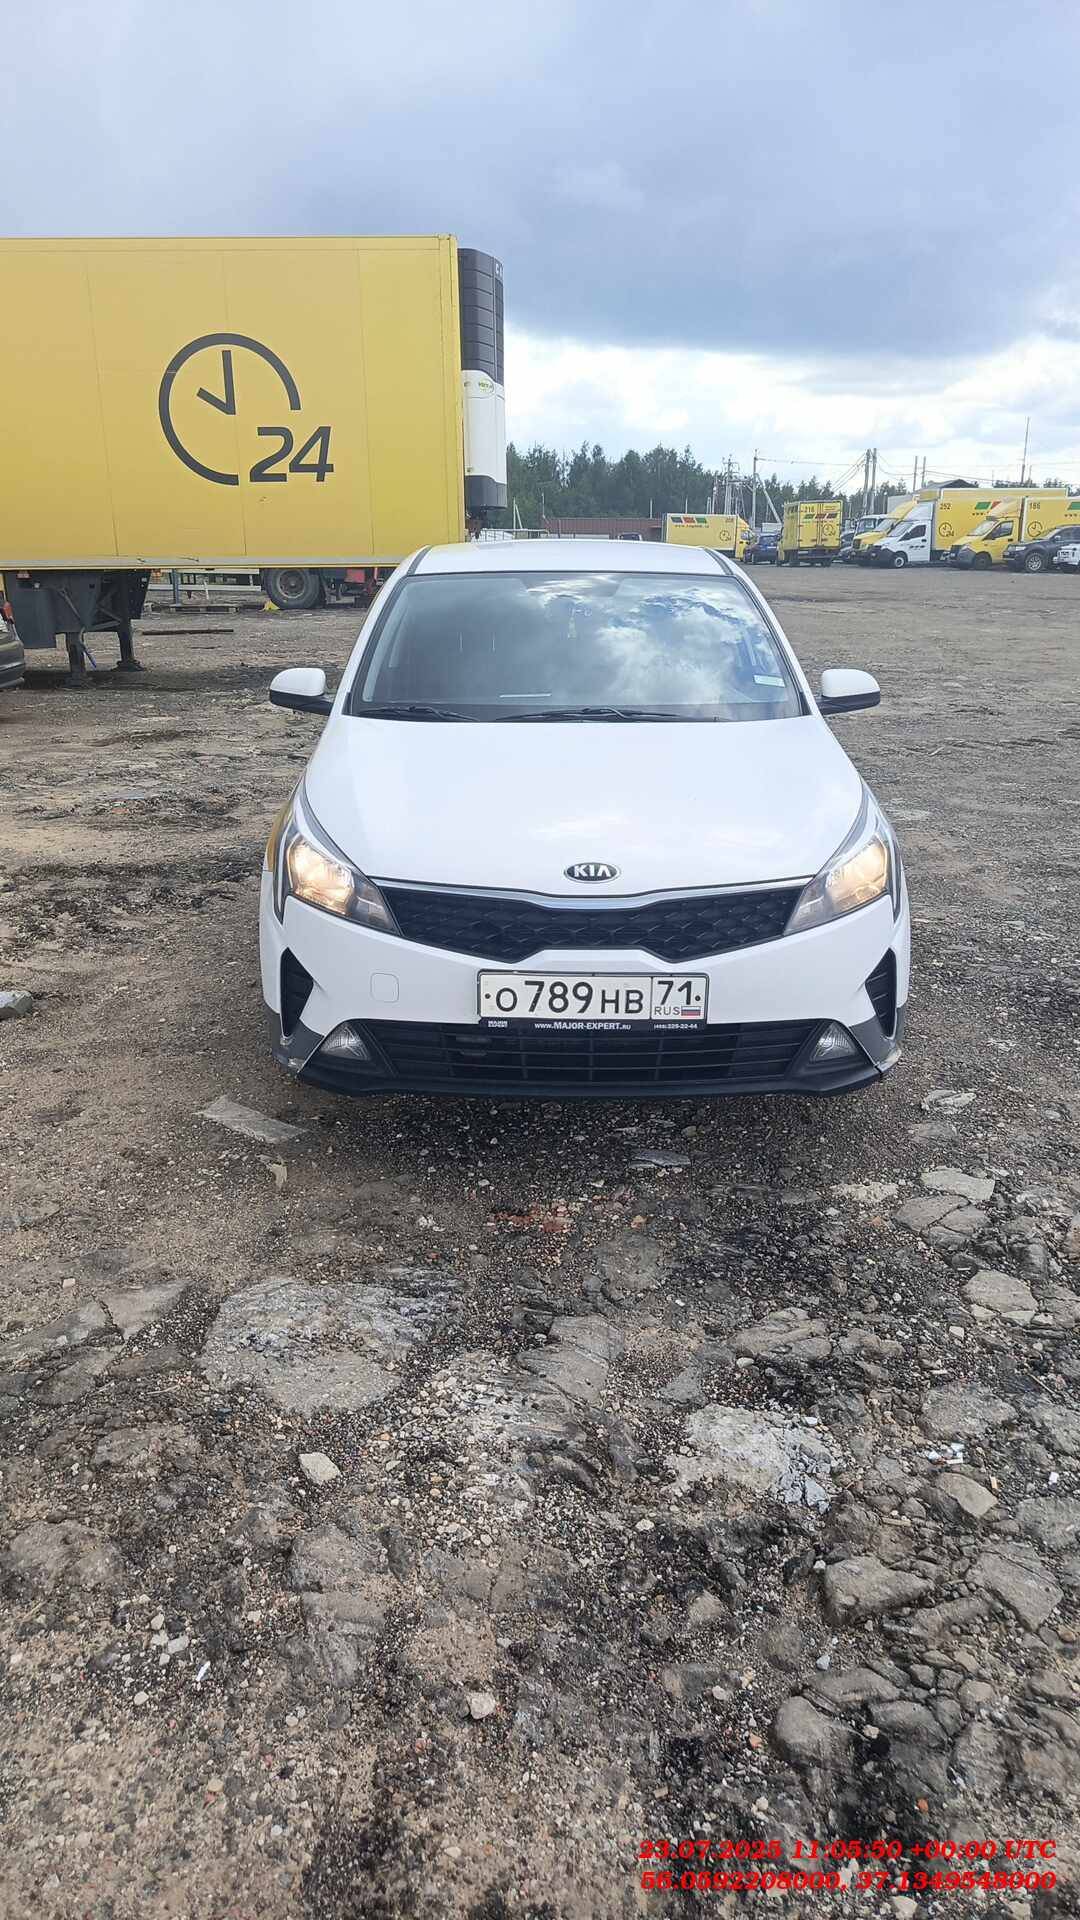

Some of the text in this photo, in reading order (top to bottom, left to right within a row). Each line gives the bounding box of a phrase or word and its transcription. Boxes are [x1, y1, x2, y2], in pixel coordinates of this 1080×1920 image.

[249, 425, 334, 482] 24
[573, 864, 612, 877] KIA
[658, 980, 692, 1006] 71
[654, 1006, 681, 1016] RUS
